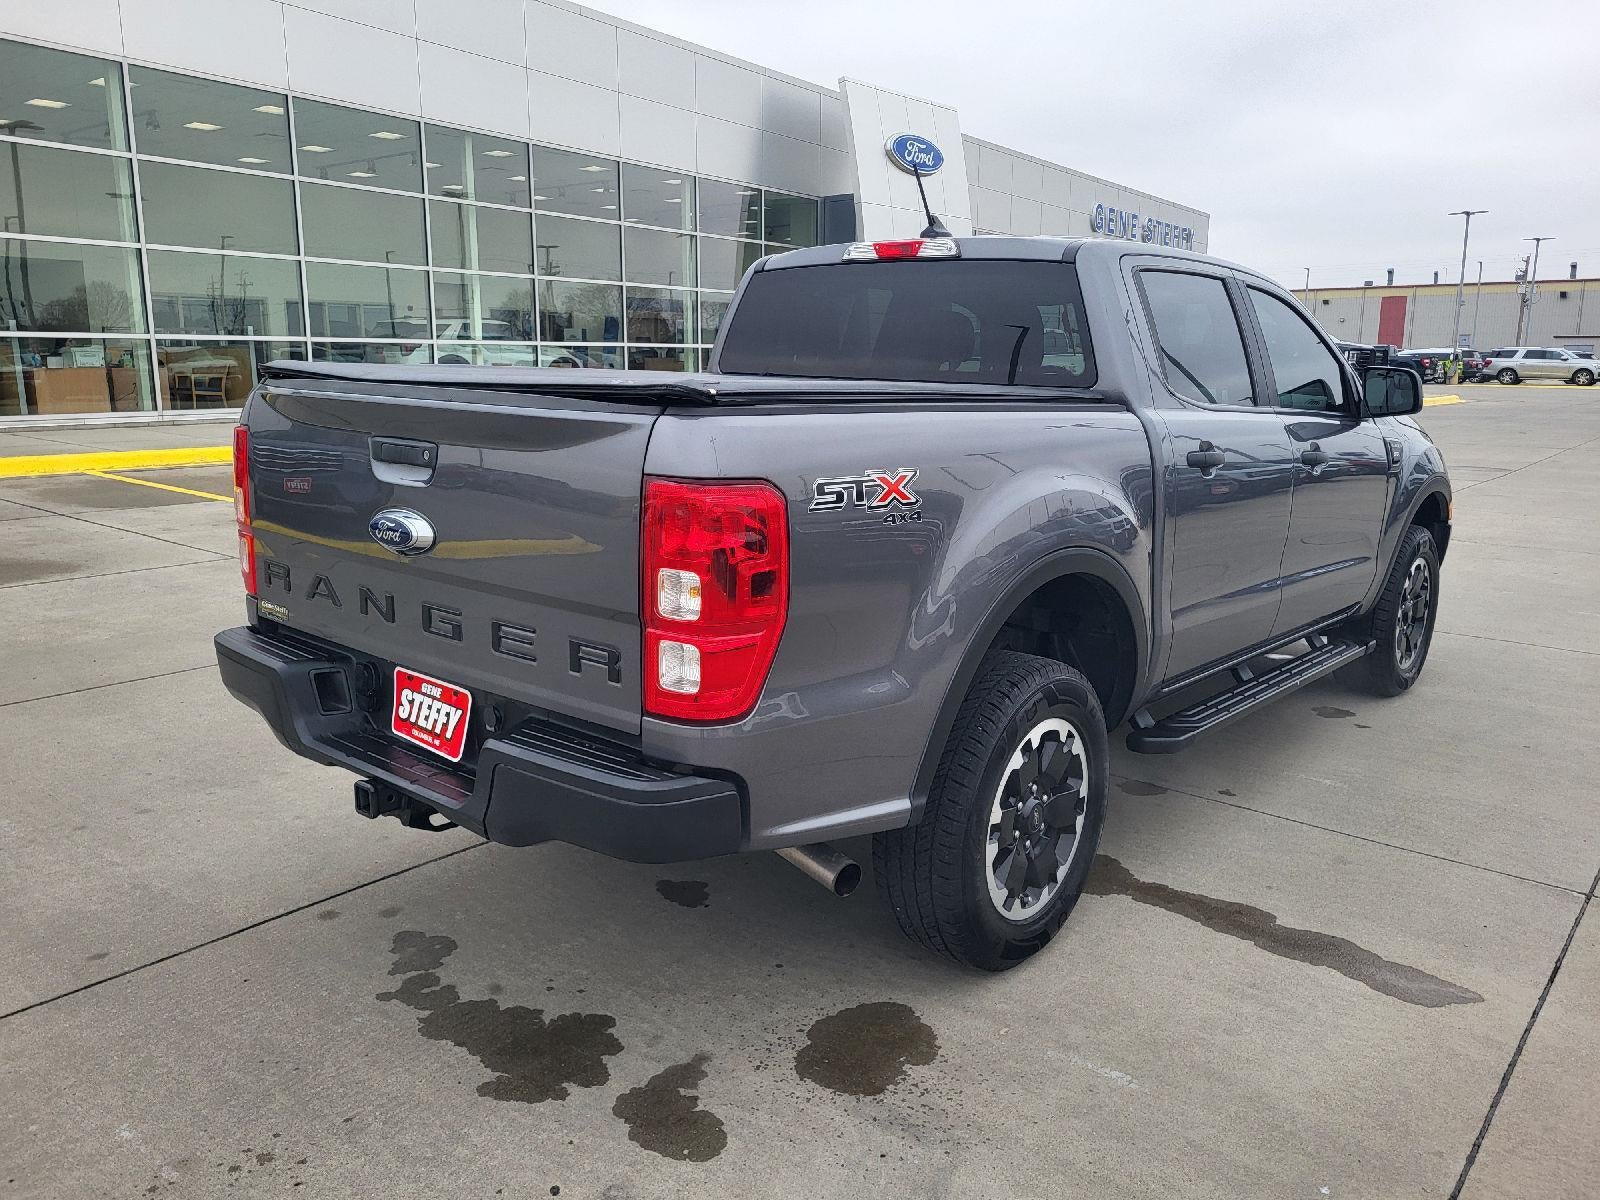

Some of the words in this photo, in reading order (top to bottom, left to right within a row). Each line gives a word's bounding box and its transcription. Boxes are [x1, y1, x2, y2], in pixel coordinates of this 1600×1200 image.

[904, 140, 935, 167] Ford
[1092, 201, 1139, 240] GENE
[1143, 216, 1195, 251] STEFFY
[798, 468, 922, 513] STX
[375, 519, 403, 542] Ford
[263, 559, 623, 686] RANGER
[421, 682, 443, 699] GENE
[398, 688, 464, 741] STEFFY
